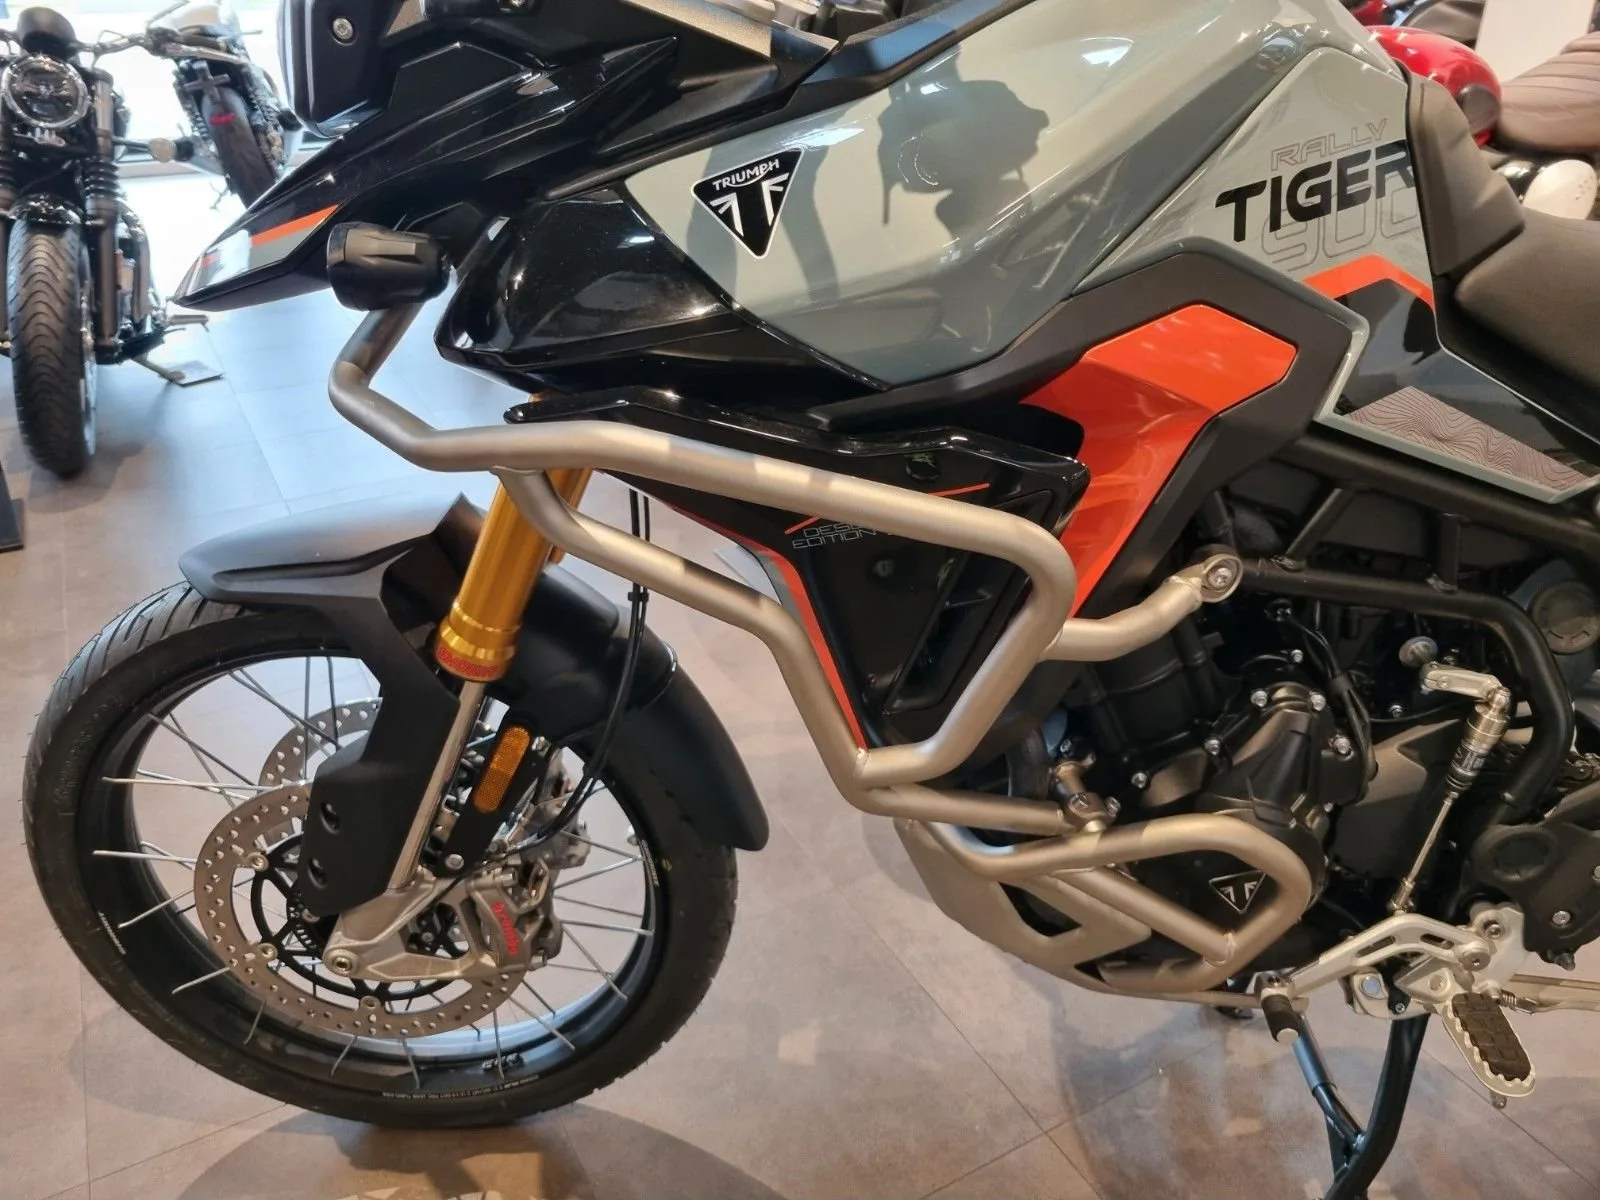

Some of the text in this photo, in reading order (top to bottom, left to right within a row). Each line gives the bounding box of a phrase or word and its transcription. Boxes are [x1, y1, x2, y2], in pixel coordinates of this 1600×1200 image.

[1271, 118, 1388, 171] RALLY
[712, 159, 780, 191] TRIUMPH
[1214, 139, 1416, 243] TIGER
[792, 530, 877, 549] EDITION
